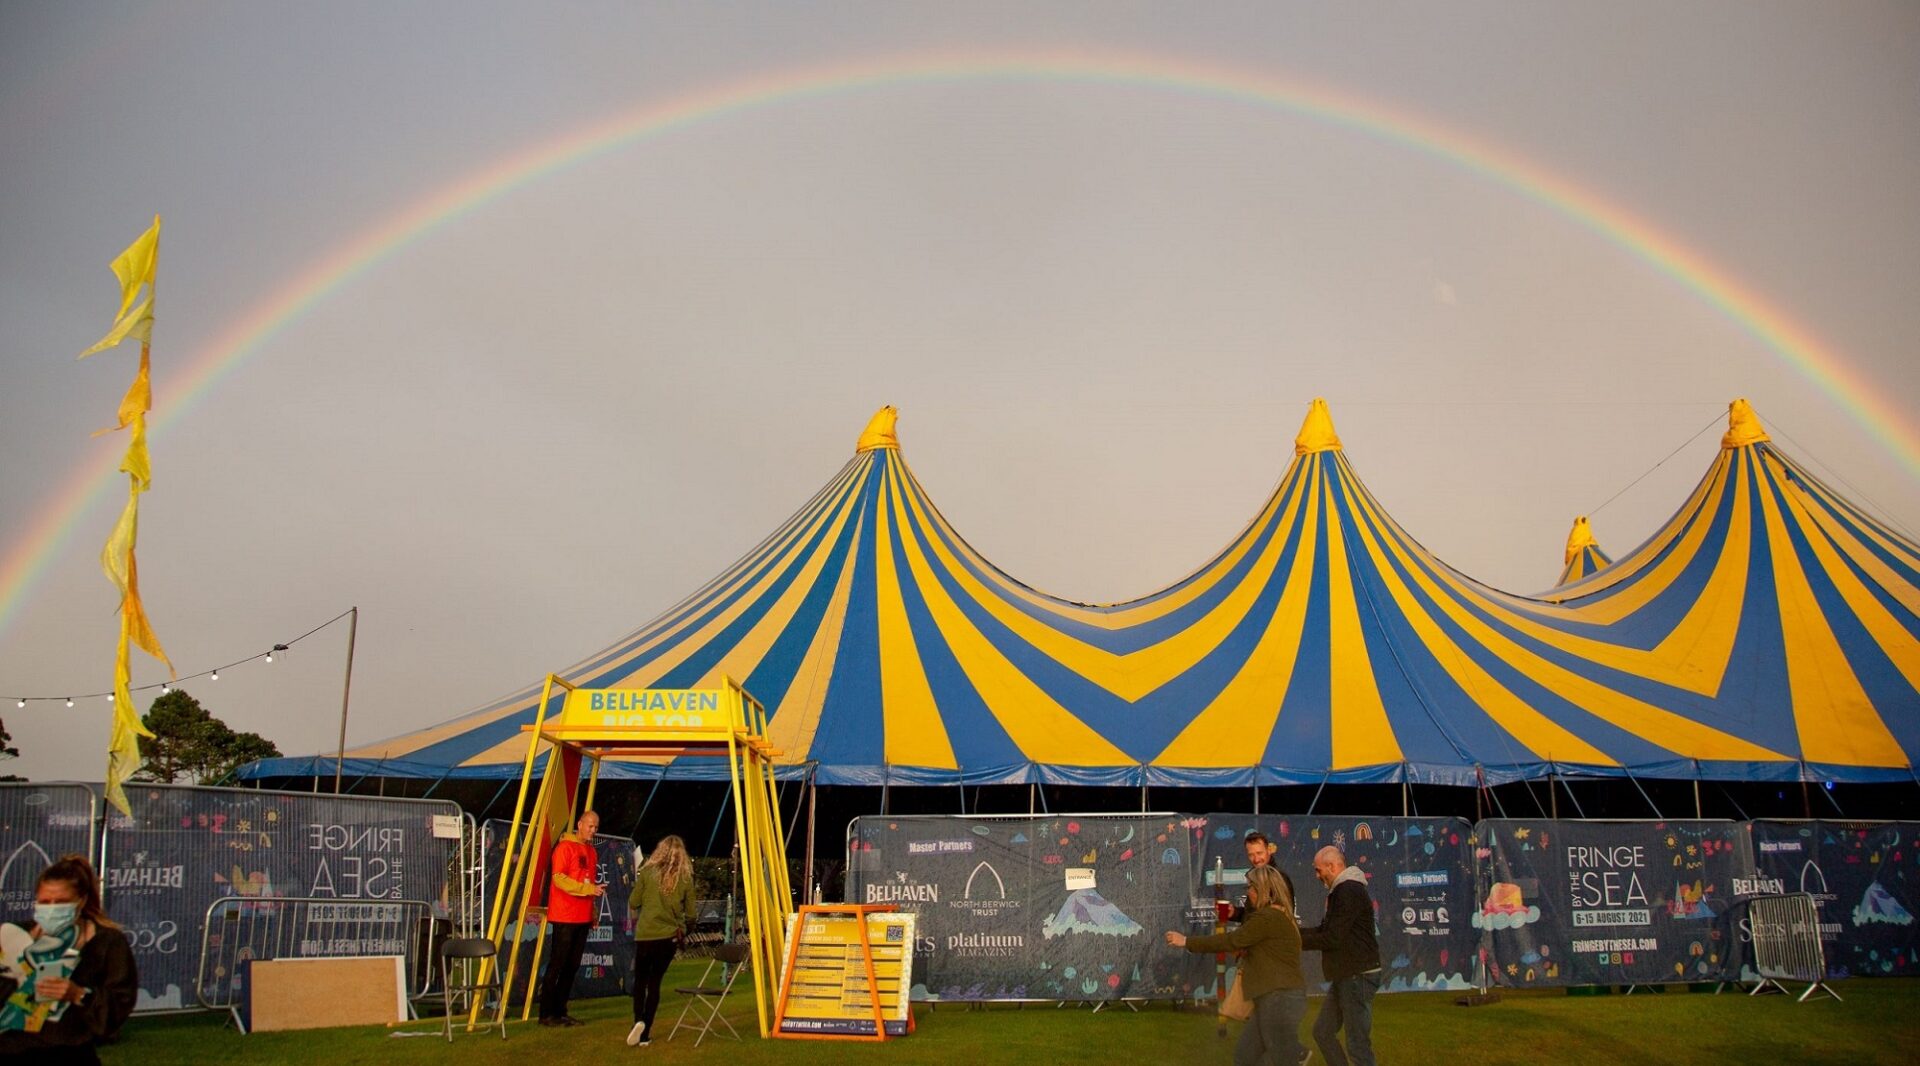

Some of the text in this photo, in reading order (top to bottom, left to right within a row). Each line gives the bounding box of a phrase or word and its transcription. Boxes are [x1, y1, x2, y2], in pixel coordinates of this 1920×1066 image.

[590, 692, 717, 711] BELHAVEN
[603, 713, 703, 734] BIG TOP
[909, 840, 972, 853] Master Partners
[1568, 846, 1645, 868] FRINGE
[866, 884, 938, 903] BELHAVEN
[1569, 871, 1582, 907] BY THE
[1582, 871, 1648, 907] SEA
[1185, 910, 1217, 918] MARIN
[1576, 911, 1648, 924] 6-15 AUGUST 2021
[948, 933, 1023, 949] platinum
[1572, 938, 1657, 952] FRINGEBYTHESEA.COM
[957, 948, 1015, 957] MAGAZINE
